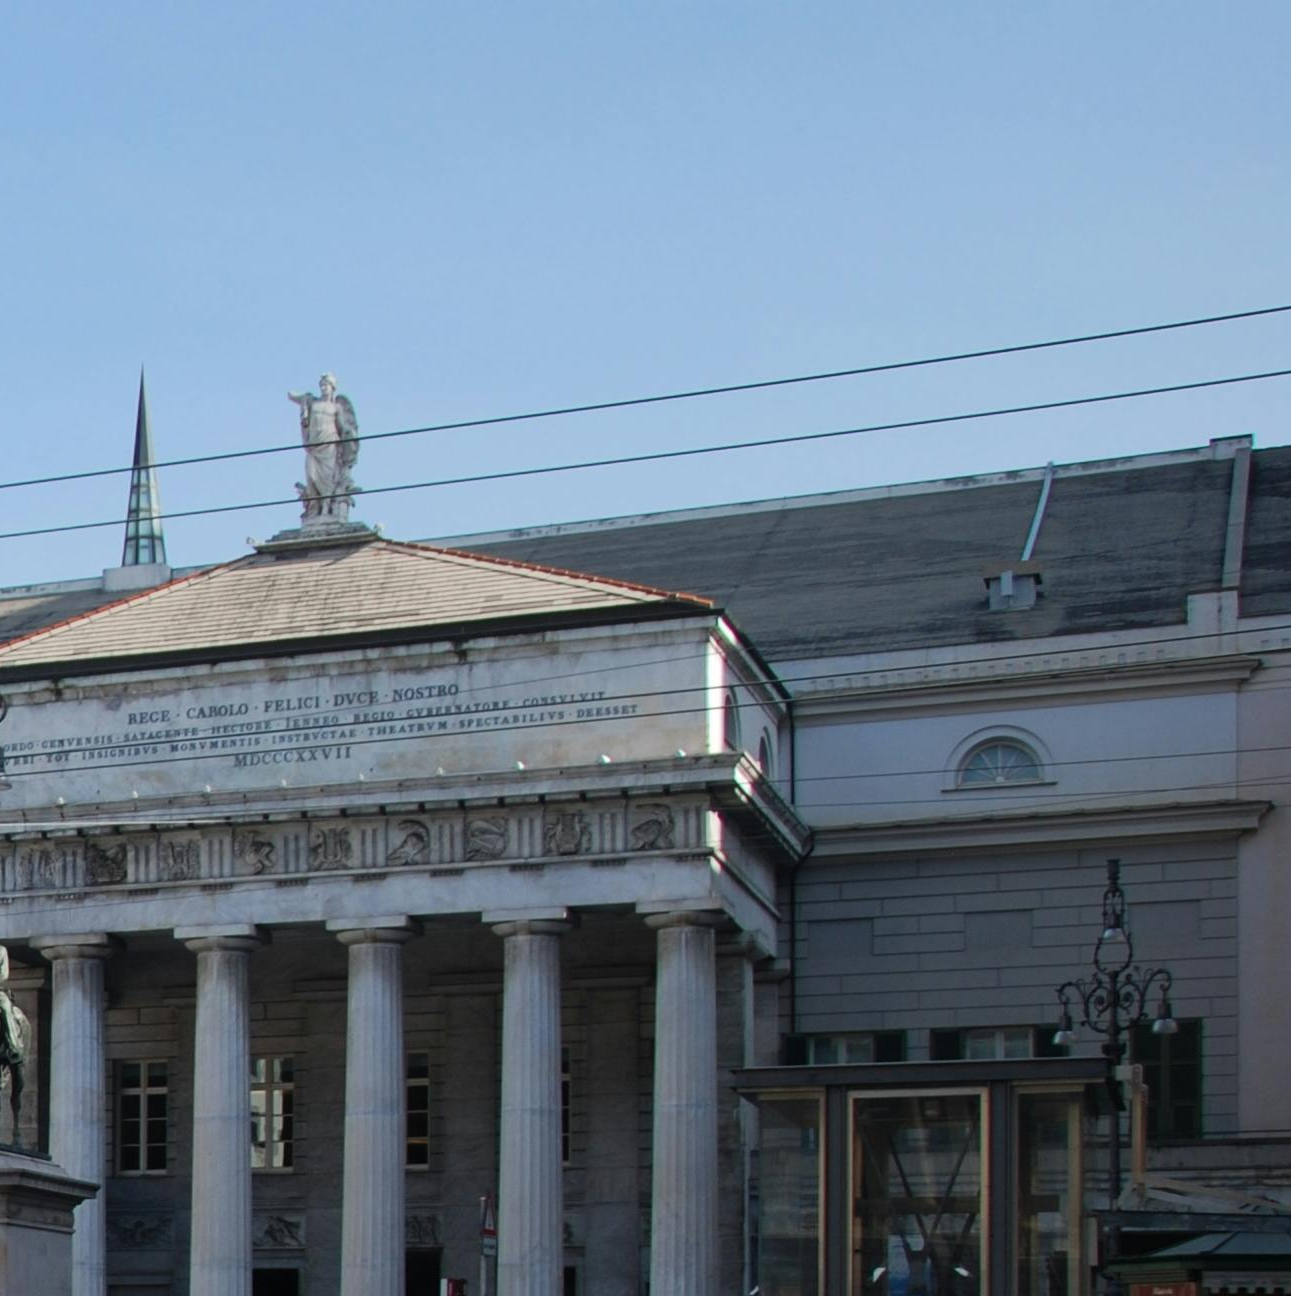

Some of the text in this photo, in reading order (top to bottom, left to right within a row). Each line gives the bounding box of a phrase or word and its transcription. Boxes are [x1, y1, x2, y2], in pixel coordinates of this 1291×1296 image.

[263, 697, 320, 713] FELICI
[333, 691, 379, 707] DVCE
[392, 683, 459, 701] NOSTRO
[576, 704, 639, 719] DEESSET
[233, 746, 351, 768] MDCCCXXVII
